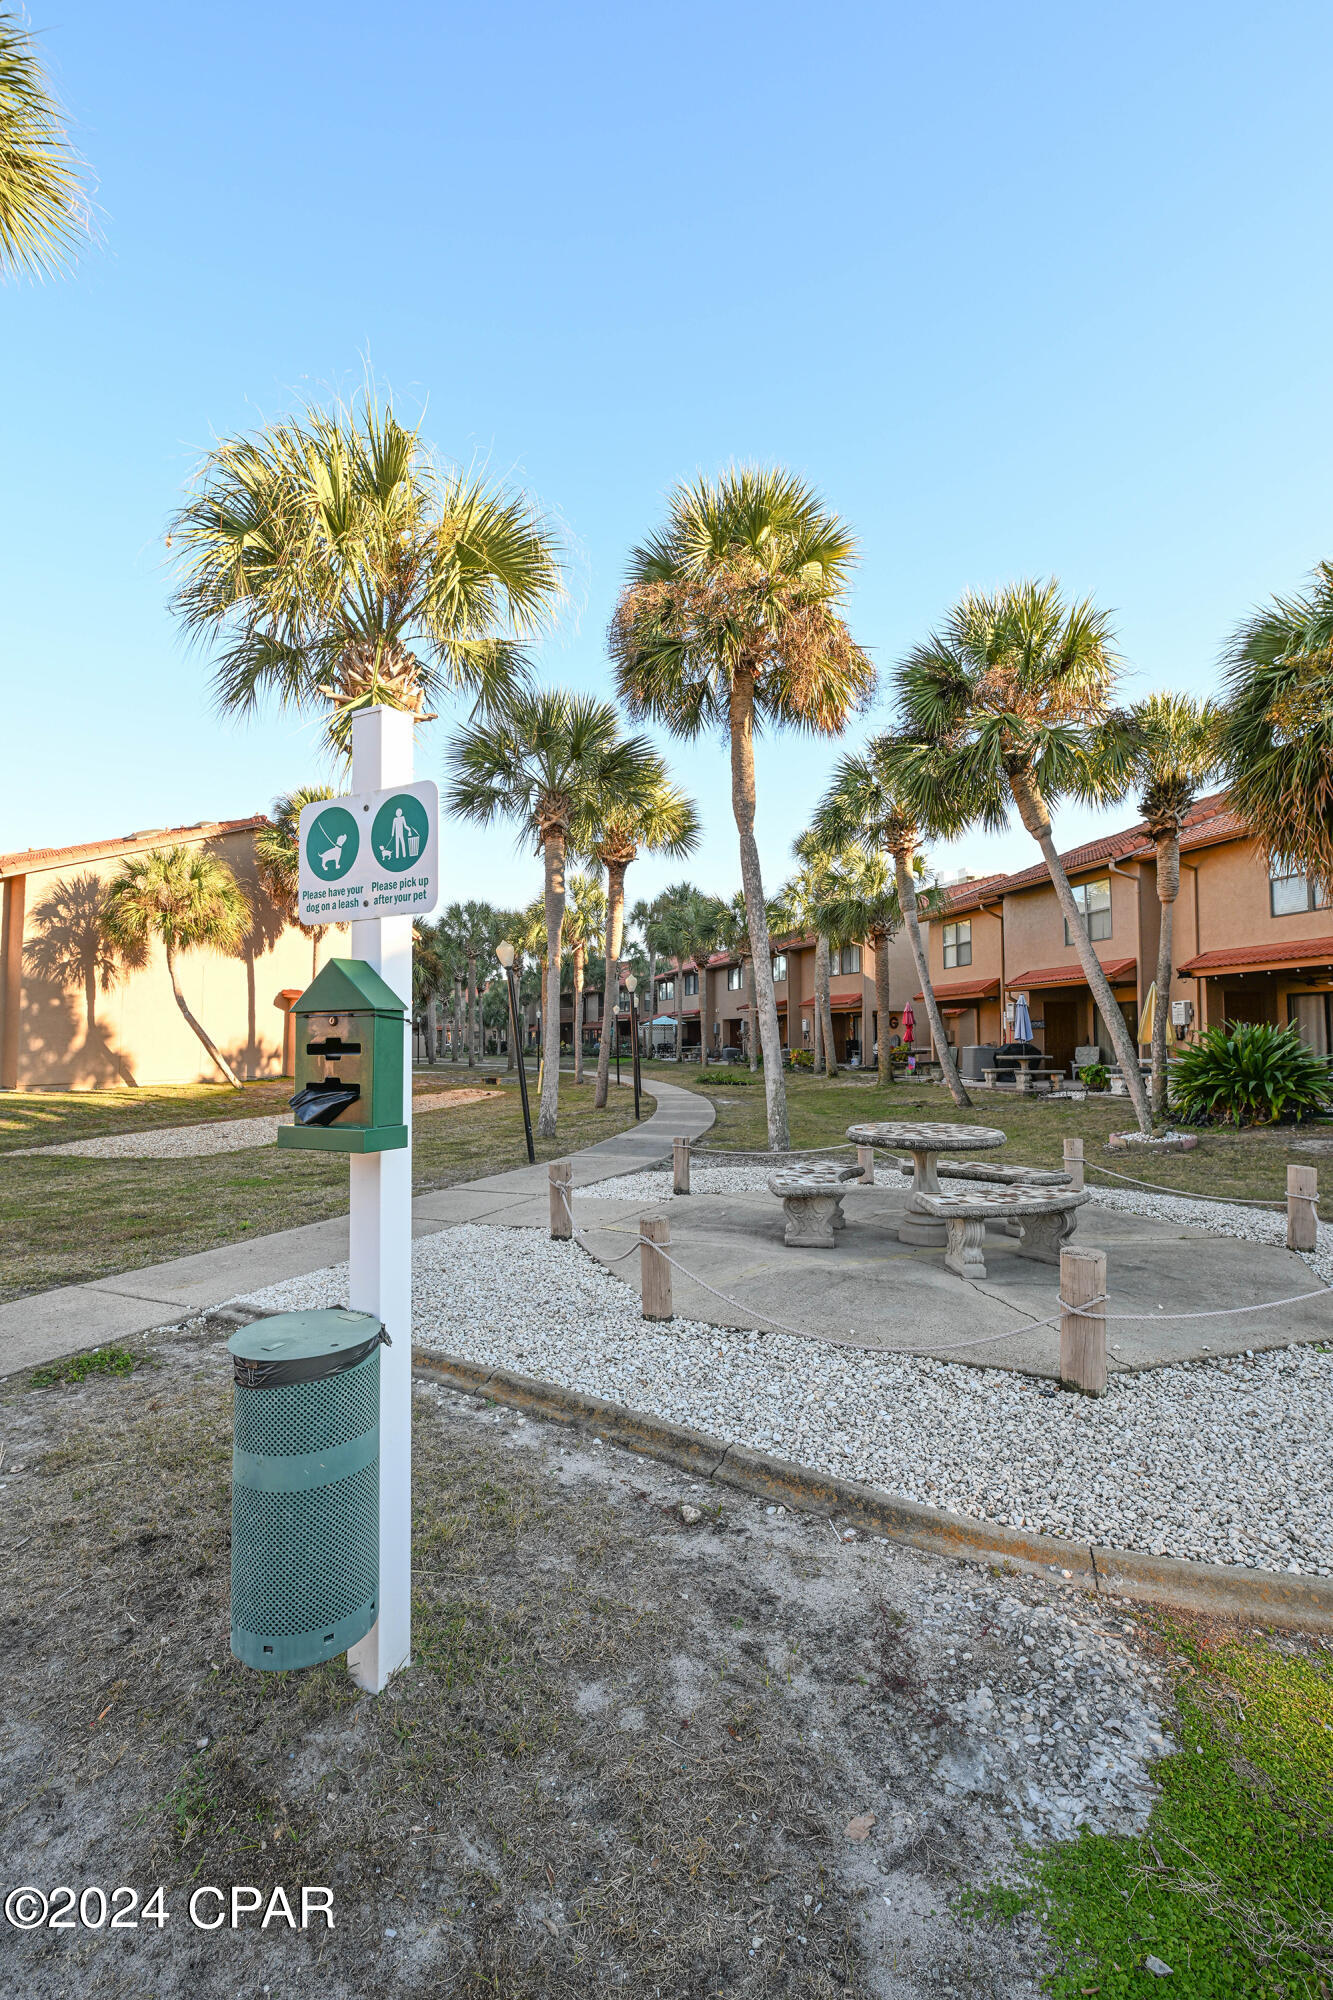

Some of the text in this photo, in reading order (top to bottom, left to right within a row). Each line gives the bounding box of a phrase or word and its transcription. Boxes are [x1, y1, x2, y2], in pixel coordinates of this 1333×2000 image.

[371, 877, 429, 892] Please pick up
[302, 886, 364, 900] Please have your
[373, 889, 427, 905] after your pet
[306, 898, 359, 914] dog on a leash
